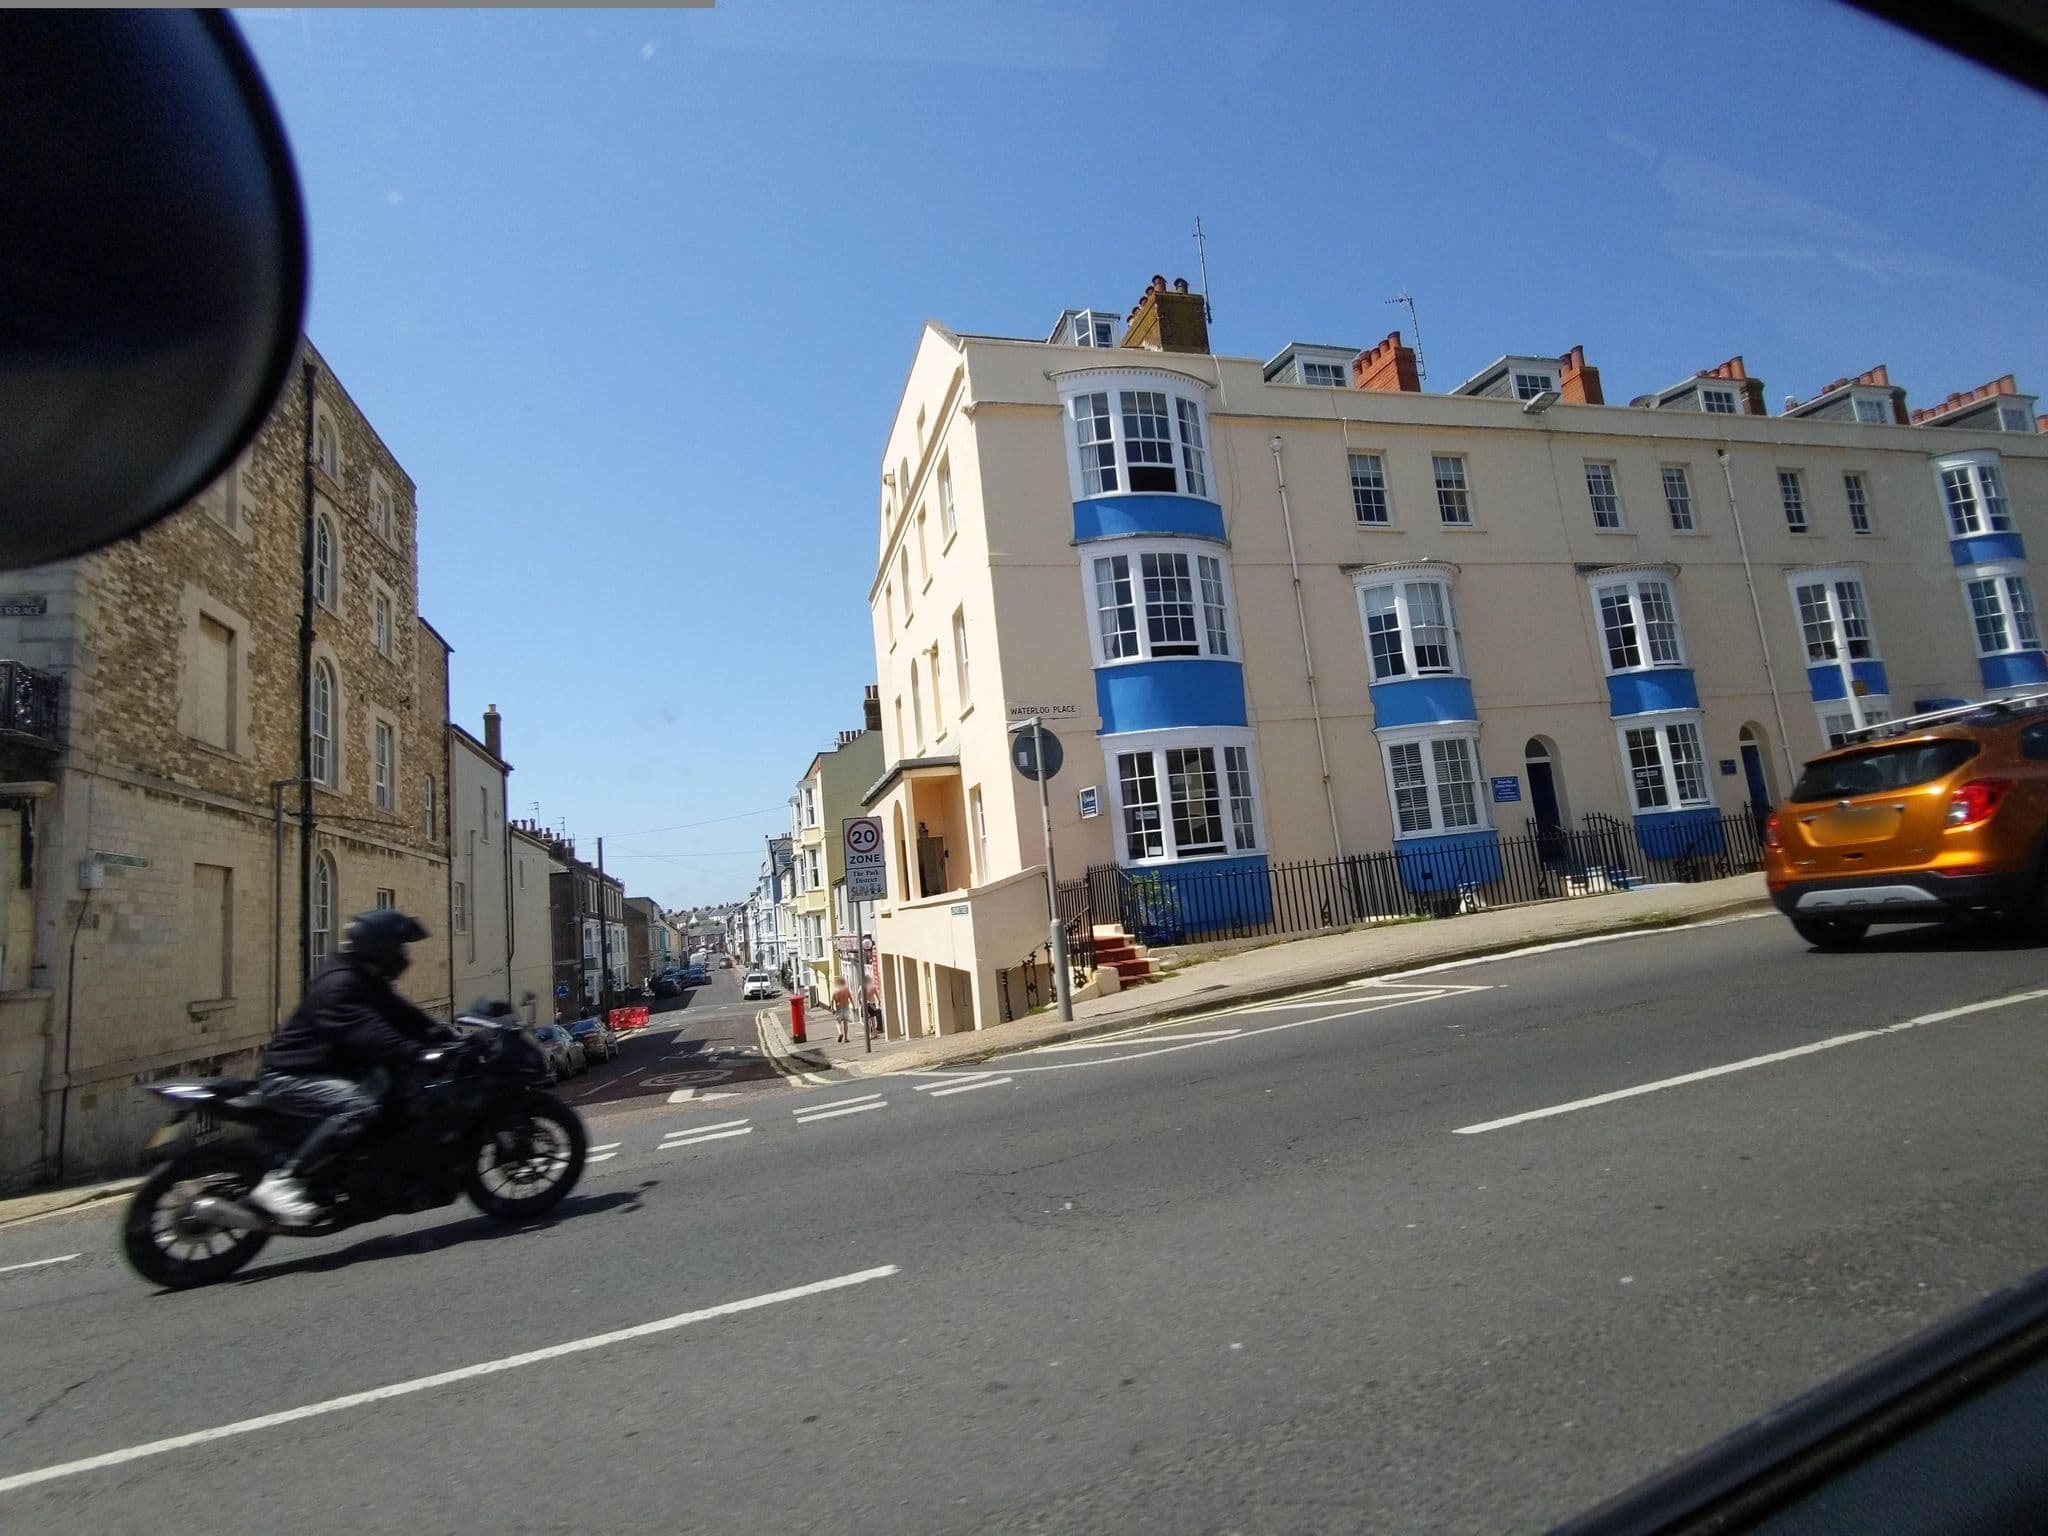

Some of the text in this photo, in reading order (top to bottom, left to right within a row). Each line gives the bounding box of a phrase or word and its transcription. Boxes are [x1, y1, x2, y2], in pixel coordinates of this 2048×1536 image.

[1010, 705, 1076, 716] WATERLOO PLACE
[852, 830, 875, 844] 20
[849, 854, 881, 865] ZONE
